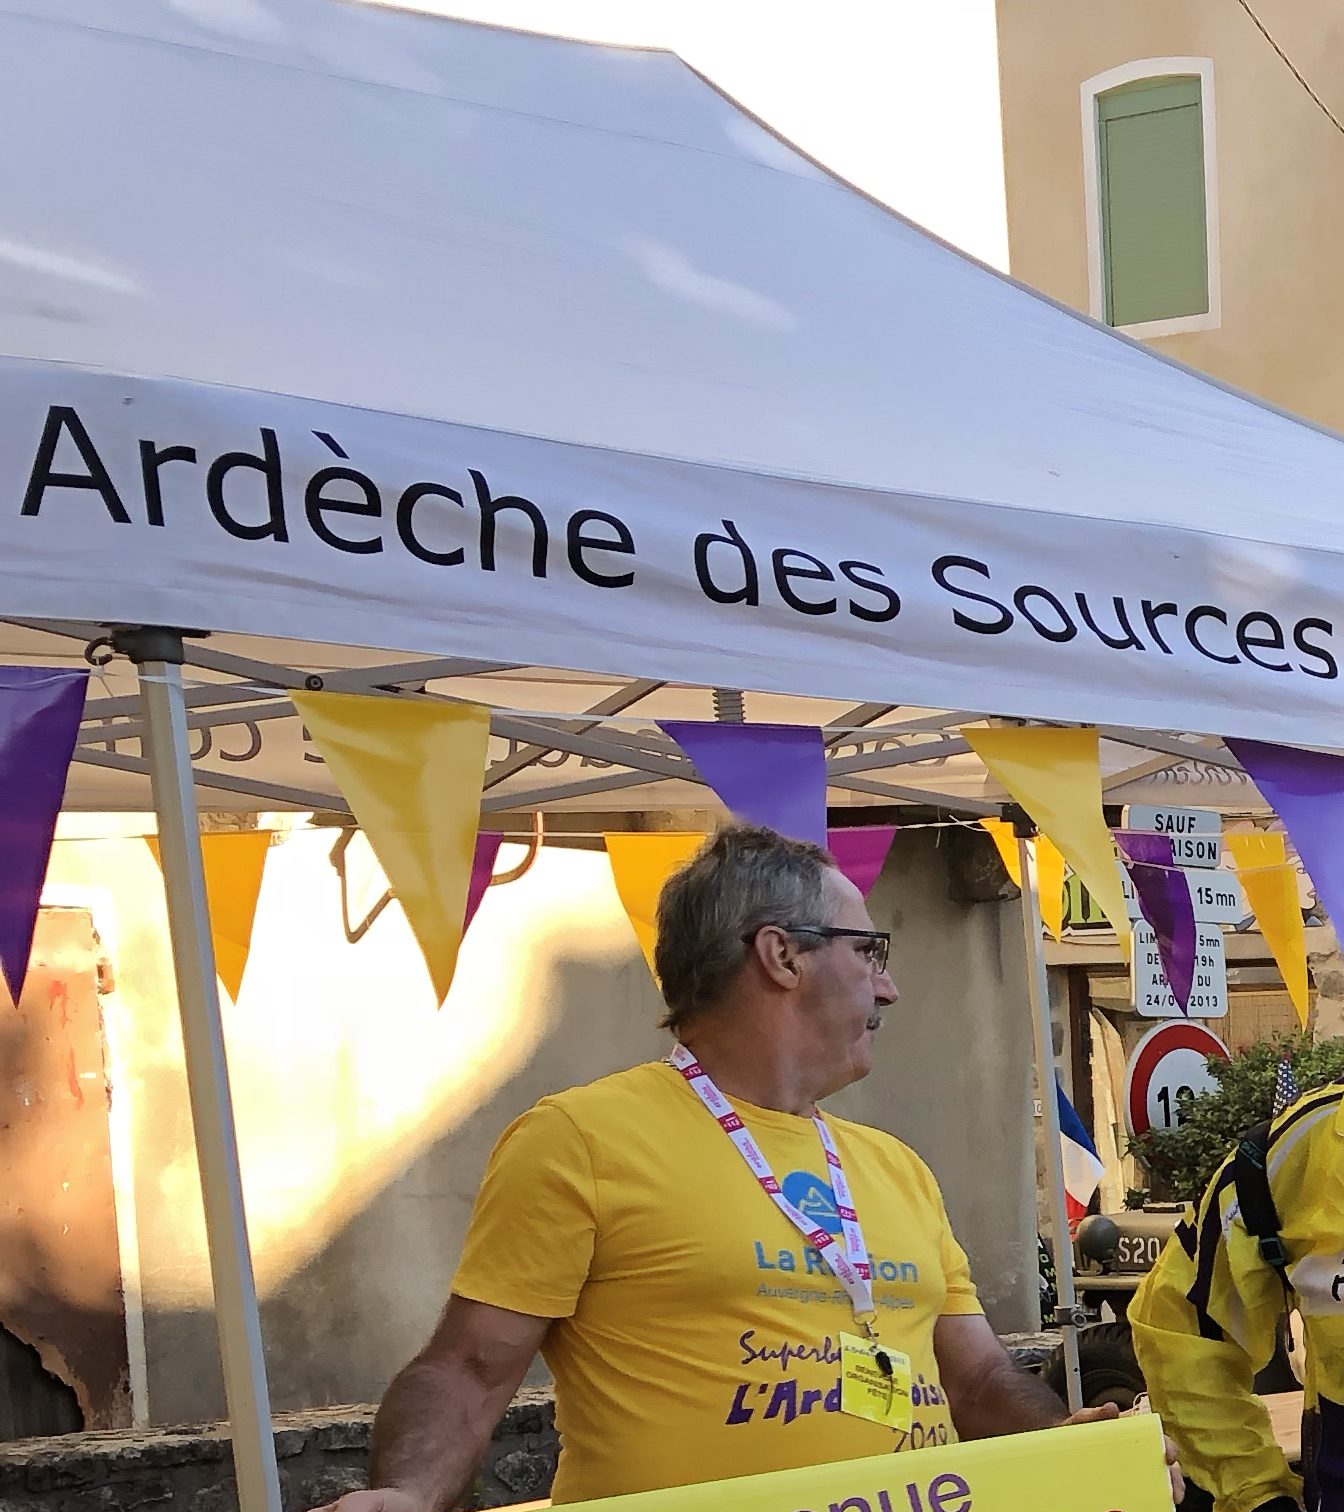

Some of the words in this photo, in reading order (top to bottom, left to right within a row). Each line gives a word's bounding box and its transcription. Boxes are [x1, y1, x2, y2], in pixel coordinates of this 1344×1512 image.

[20, 404, 636, 589] Ardèche
[694, 519, 903, 624] des
[931, 554, 1337, 681] Sources
[1154, 813, 1196, 834] SAUF
[753, 1240, 796, 1271] La
[804, 1246, 918, 1283] Rion
[739, 1330, 842, 1371] Superb
[725, 1374, 946, 1425] L'Ardois
